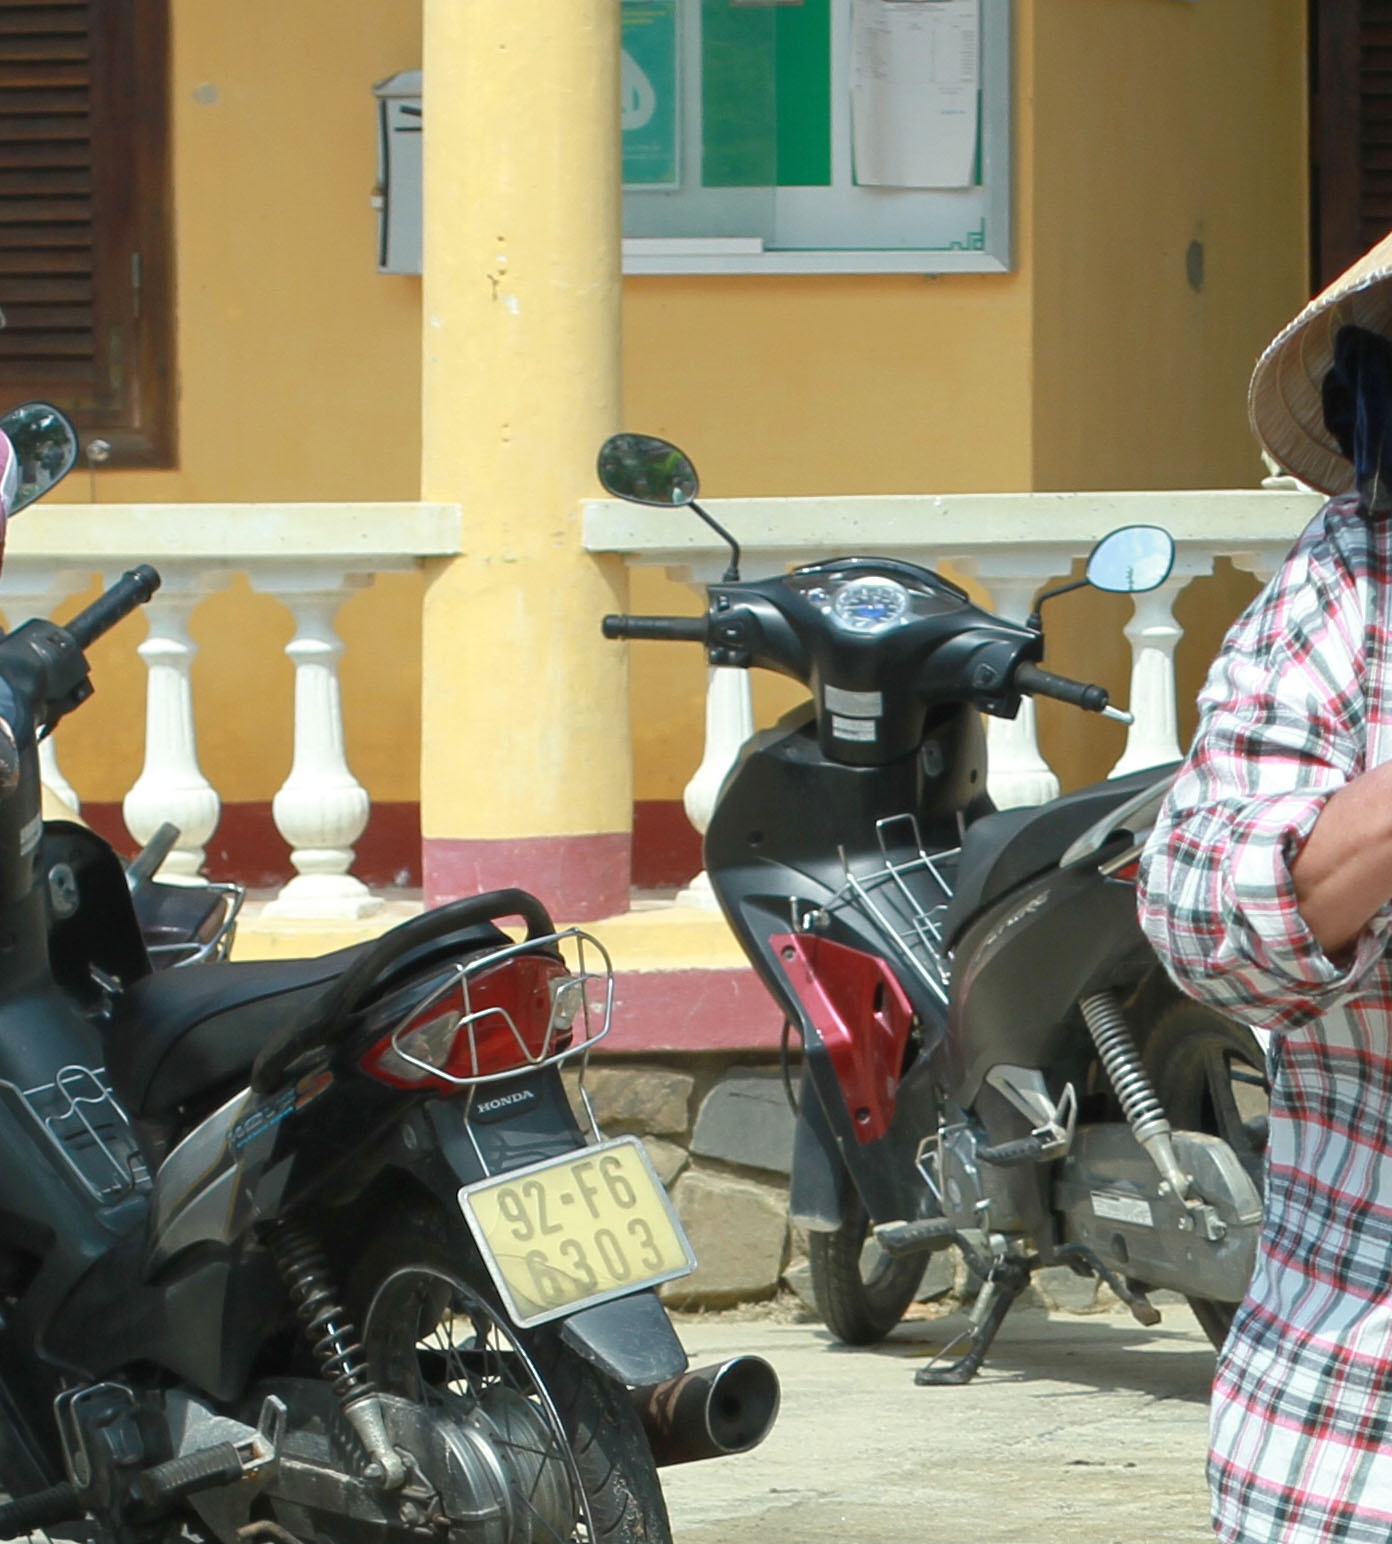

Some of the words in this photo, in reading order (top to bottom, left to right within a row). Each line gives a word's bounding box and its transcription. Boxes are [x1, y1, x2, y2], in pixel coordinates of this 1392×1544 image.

[476, 1089, 535, 1114] HONDA
[495, 1155, 638, 1243] 92-F6
[523, 1216, 667, 1304] 6303
